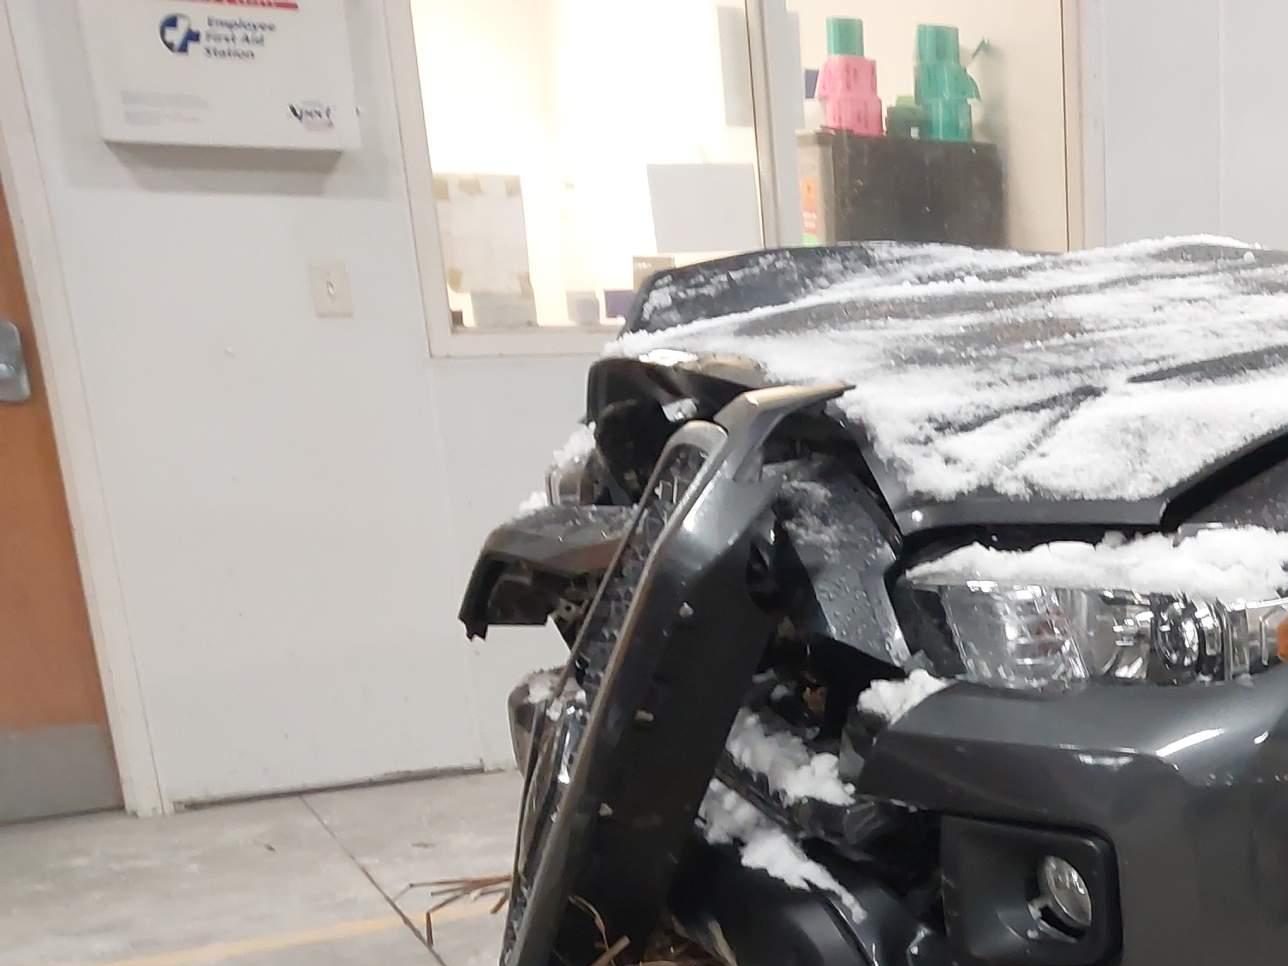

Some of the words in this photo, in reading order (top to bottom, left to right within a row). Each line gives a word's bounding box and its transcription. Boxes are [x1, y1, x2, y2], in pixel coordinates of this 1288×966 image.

[207, 15, 276, 31] Employee
[206, 32, 236, 45] First
[241, 33, 264, 46] Aid
[204, 46, 254, 59] Station
